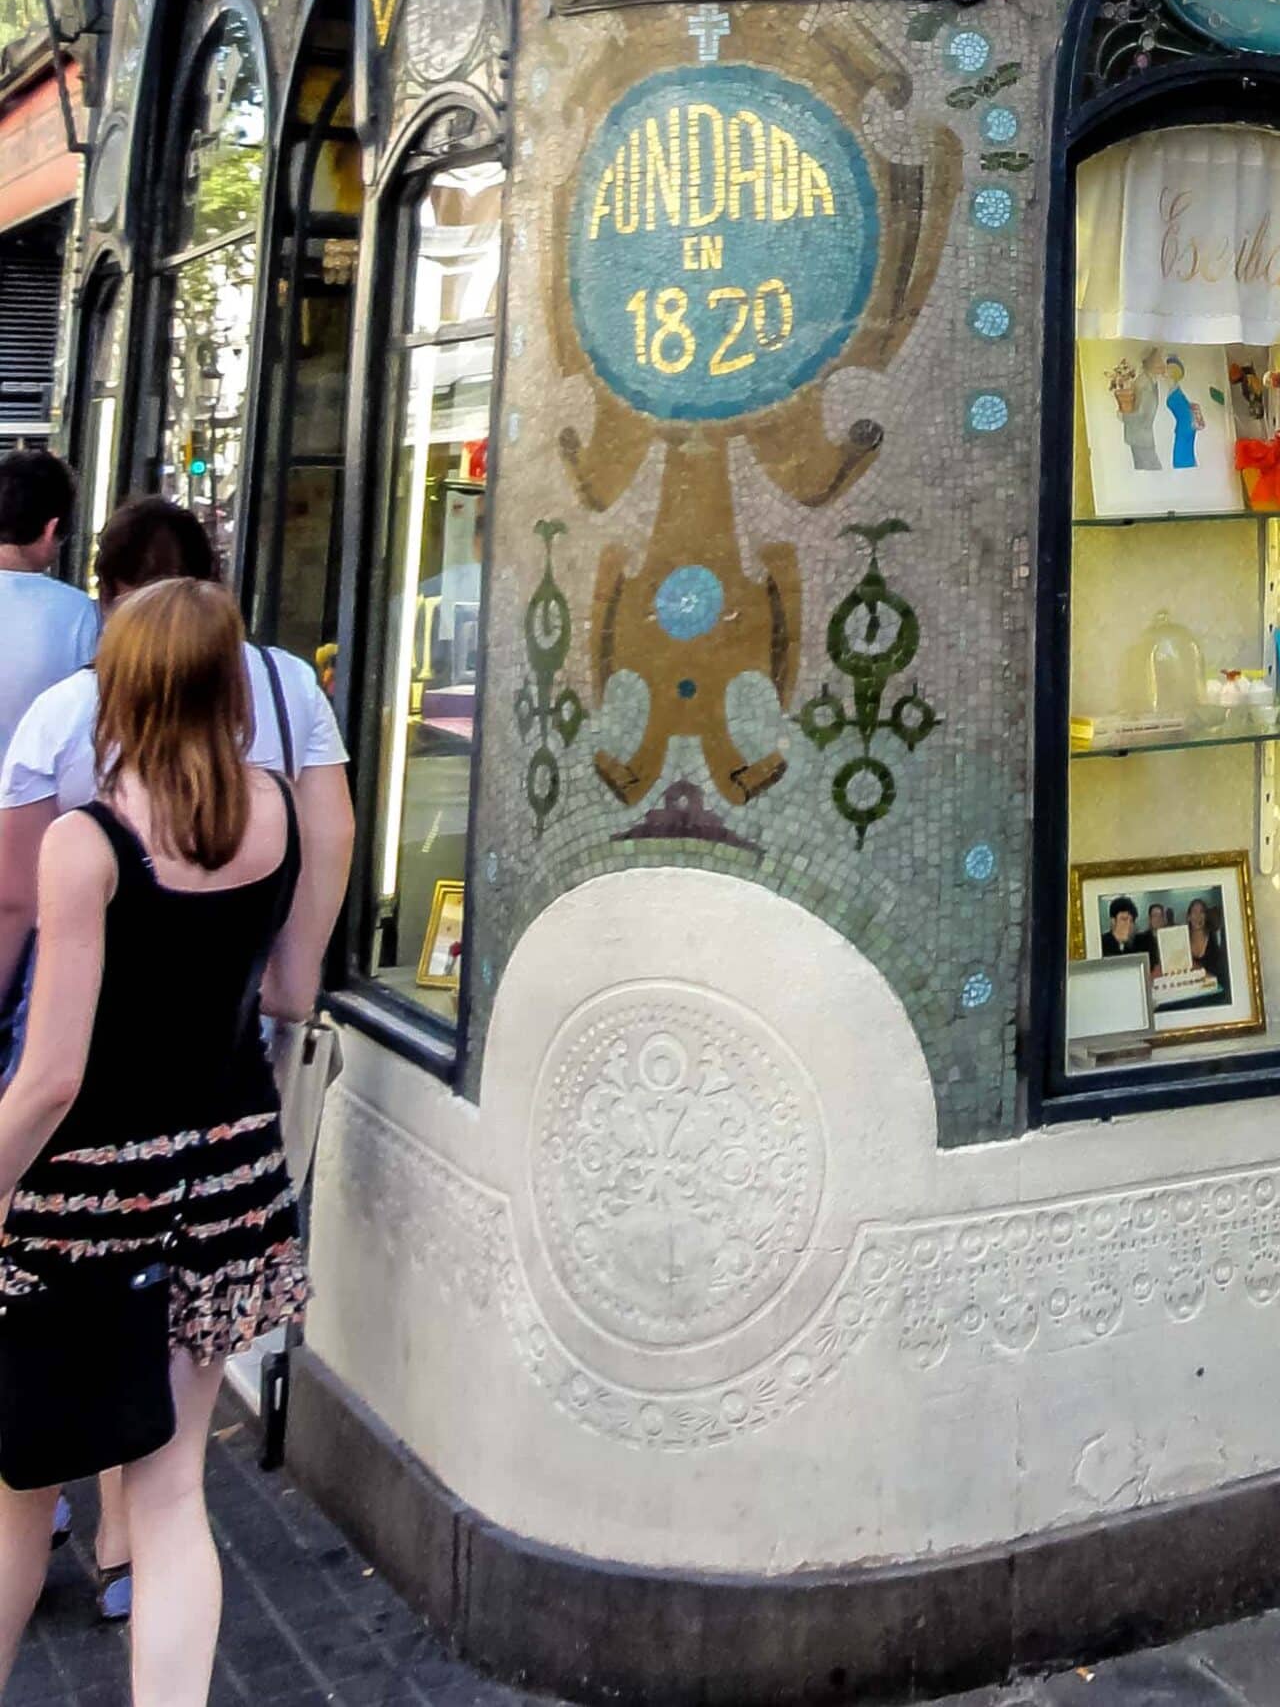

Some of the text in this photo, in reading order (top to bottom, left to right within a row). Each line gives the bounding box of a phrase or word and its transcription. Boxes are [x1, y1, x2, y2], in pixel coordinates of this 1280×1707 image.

[589, 103, 836, 241] FUNDADA
[683, 234, 724, 271] EN
[625, 277, 794, 376] 1820
